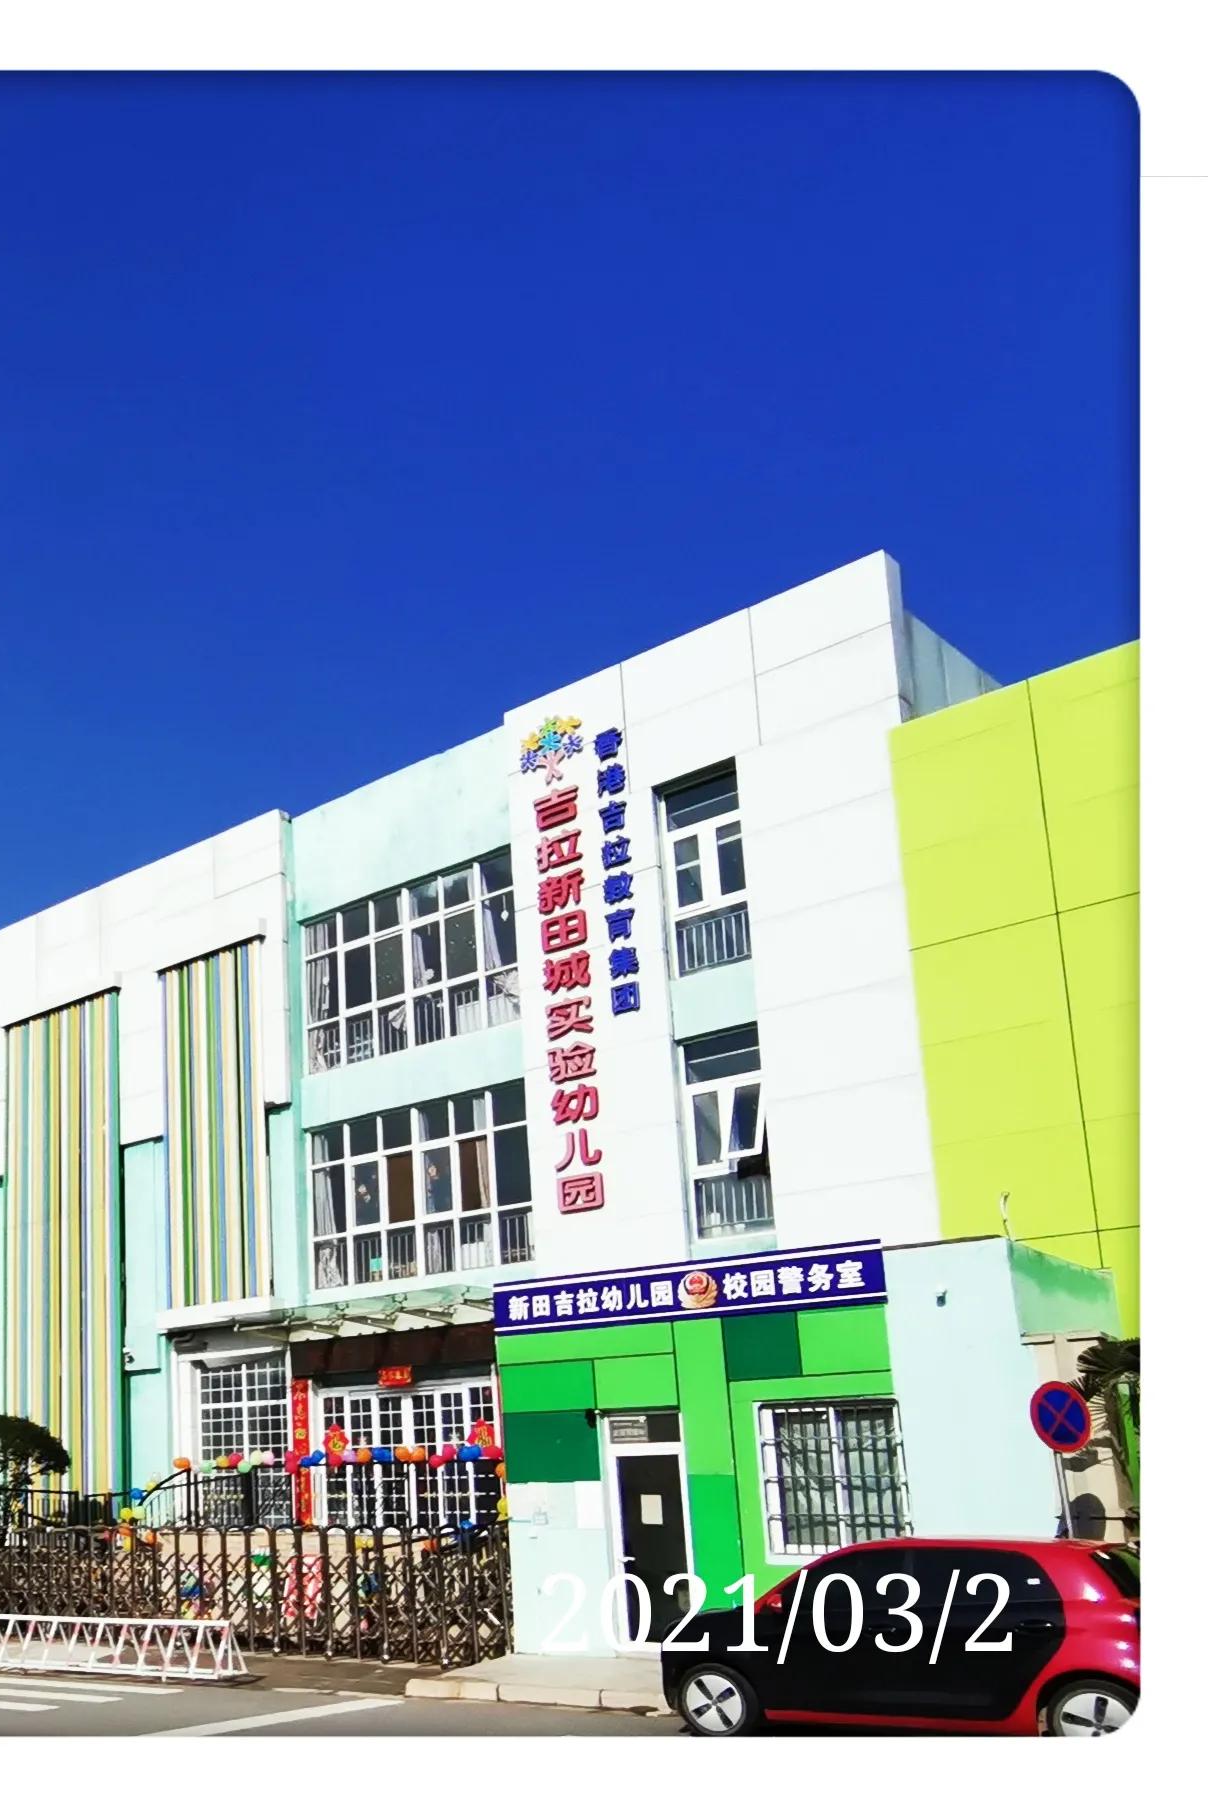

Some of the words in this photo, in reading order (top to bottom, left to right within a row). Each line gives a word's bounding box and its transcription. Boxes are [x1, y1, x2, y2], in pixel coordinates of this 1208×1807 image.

[532, 783, 605, 1215] 吉拉新田城实验幼儿园
[593, 727, 640, 1016] 香港吉拉教育集团
[508, 1280, 674, 1321] 新田吉拉幼儿园
[722, 1259, 866, 1301] 校园警务室
